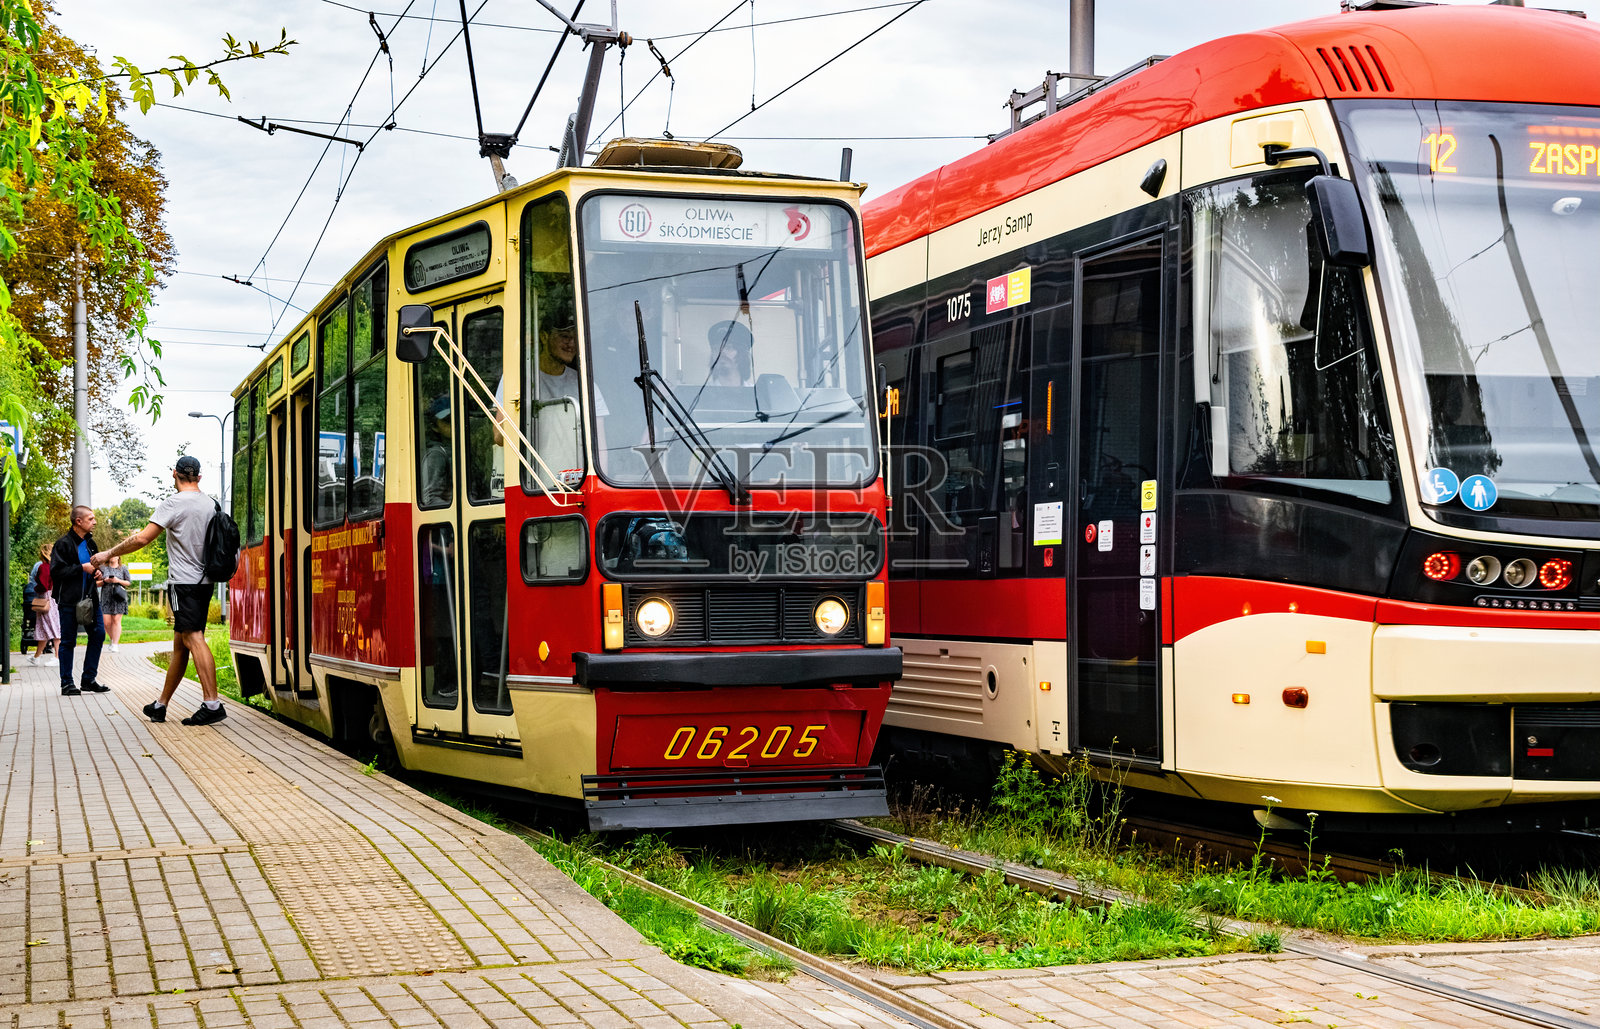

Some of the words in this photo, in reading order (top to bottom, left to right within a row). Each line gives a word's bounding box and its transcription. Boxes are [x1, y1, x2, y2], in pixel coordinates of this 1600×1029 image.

[1421, 132, 1458, 173] 12
[1528, 142, 1600, 177] ZASP
[625, 210, 646, 233] 60
[685, 207, 734, 221] OLIWA
[659, 221, 753, 240] ŚRÓDMIEŚCIE
[977, 225, 1003, 247] Jerzy
[1005, 212, 1033, 235] Samp
[451, 242, 470, 256] OLIWA
[946, 292, 971, 322] 1075
[663, 723, 827, 760] 06205
